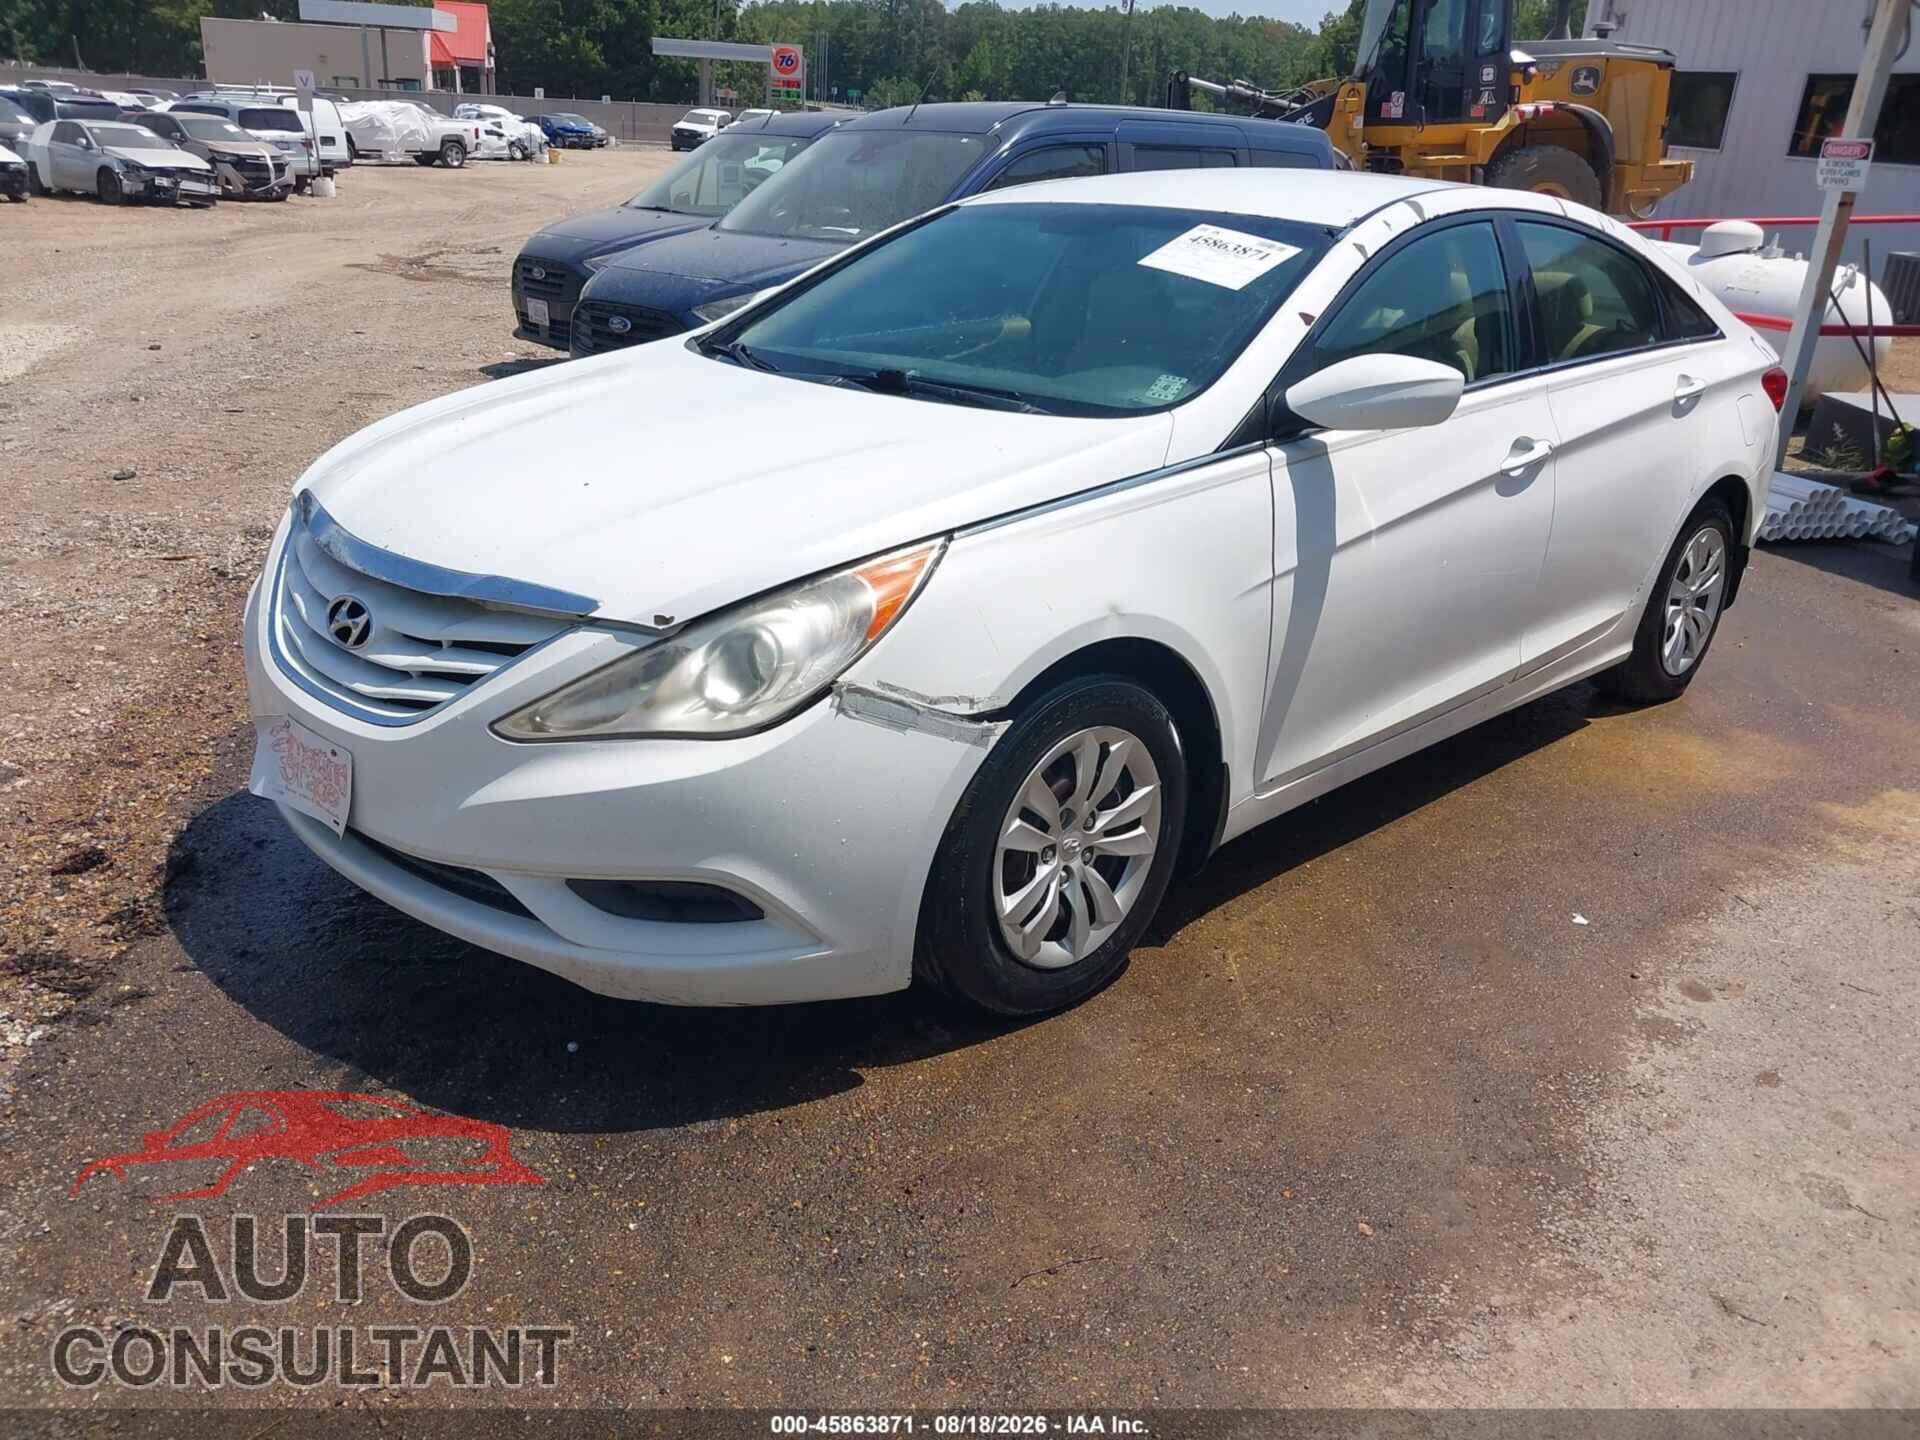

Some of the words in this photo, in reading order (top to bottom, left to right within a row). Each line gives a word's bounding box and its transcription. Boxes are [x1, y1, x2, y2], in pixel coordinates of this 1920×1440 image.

[779, 54, 794, 67] 76
[299, 75, 309, 87] V
[1189, 235, 1271, 261] 45863871
